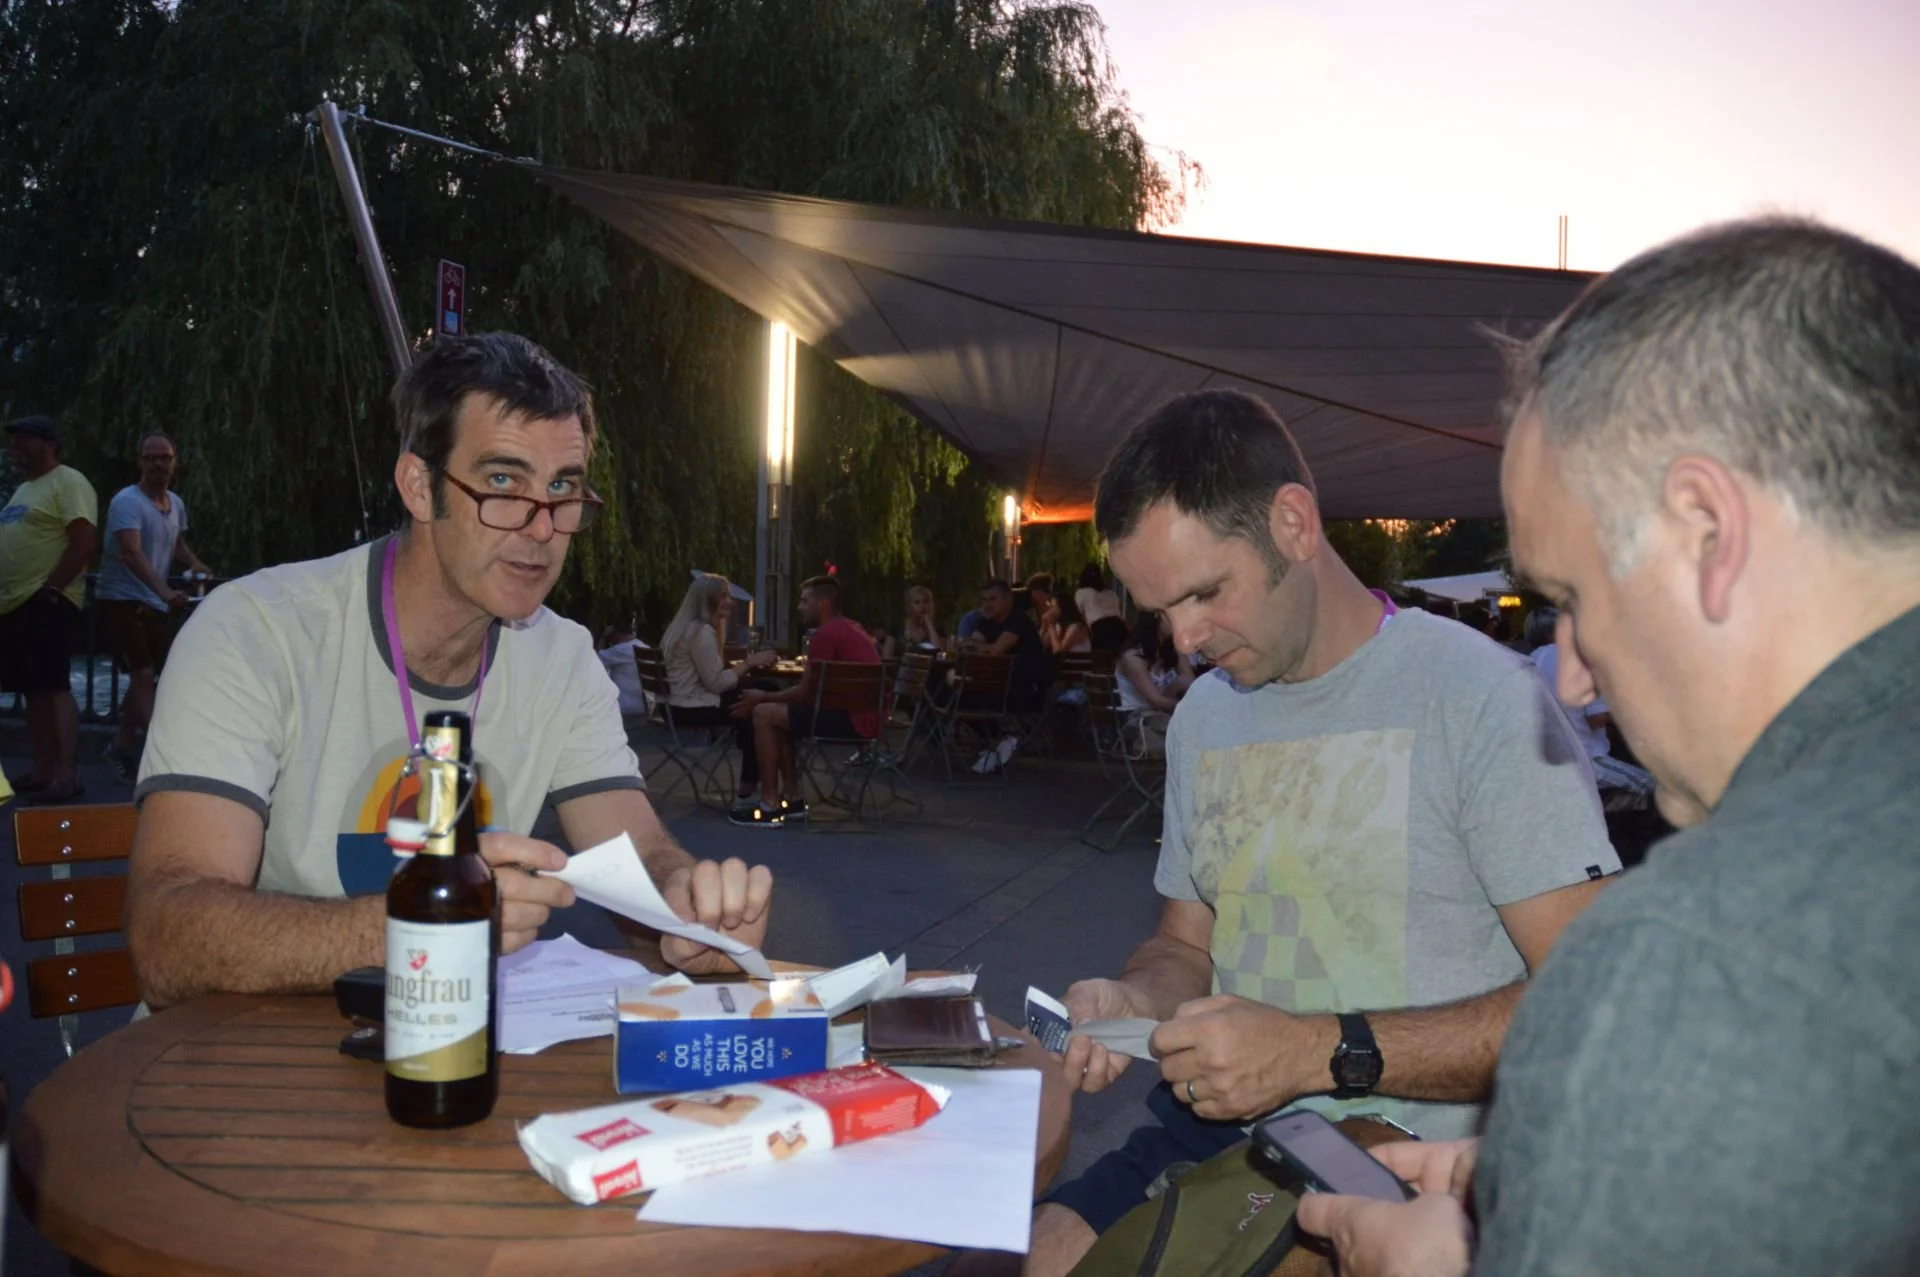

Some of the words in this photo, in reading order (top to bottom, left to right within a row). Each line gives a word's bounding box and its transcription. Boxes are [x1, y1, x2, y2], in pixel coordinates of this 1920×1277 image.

[387, 968, 471, 1009] ungfrau
[692, 1039, 701, 1053] AS
[704, 1032, 713, 1047] AS
[717, 1036, 731, 1072] THIS
[733, 1035, 748, 1073] LOVE
[751, 1037, 765, 1070] YOU
[674, 1044, 689, 1069] DO
[692, 1054, 701, 1071] WE
[704, 1048, 713, 1077] MUCH
